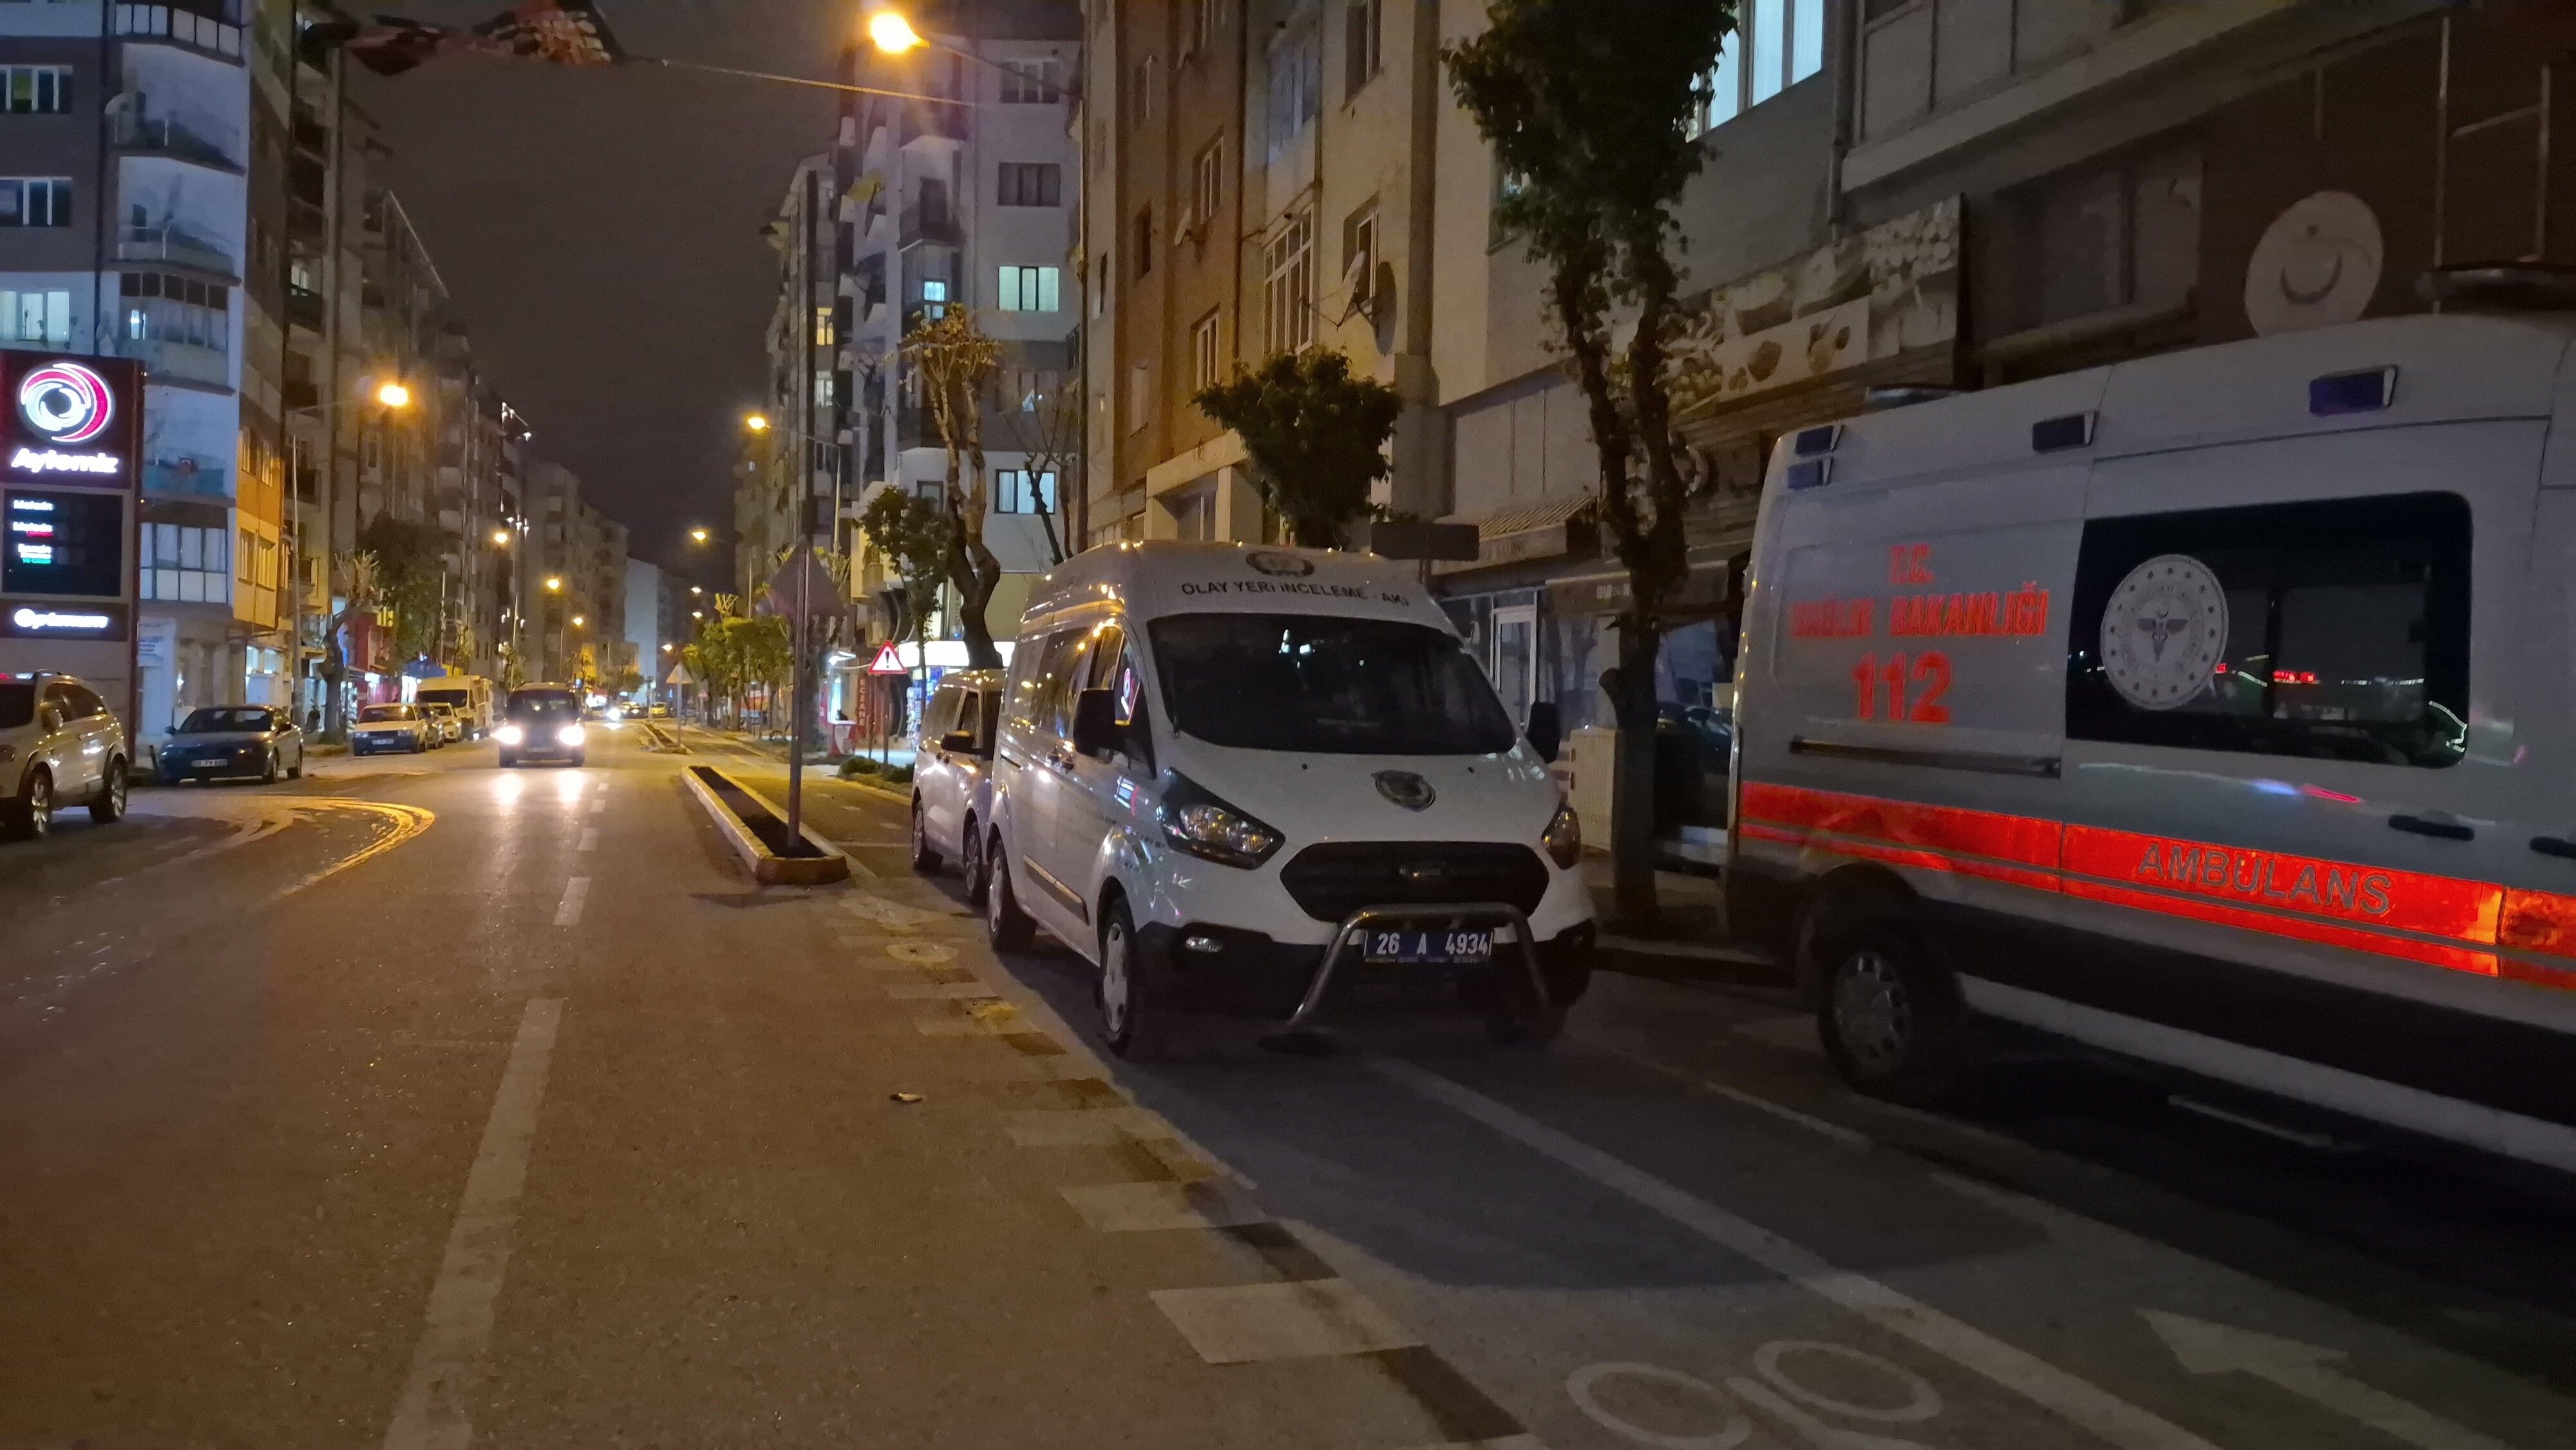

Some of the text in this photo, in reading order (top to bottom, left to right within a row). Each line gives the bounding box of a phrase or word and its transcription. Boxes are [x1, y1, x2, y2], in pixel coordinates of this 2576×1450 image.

[1181, 581, 1228, 595] OLAY
[1852, 650, 1951, 723] 112
[2137, 842, 2392, 915] AMBULANS
[1376, 932, 1488, 956] 26 A 4934
